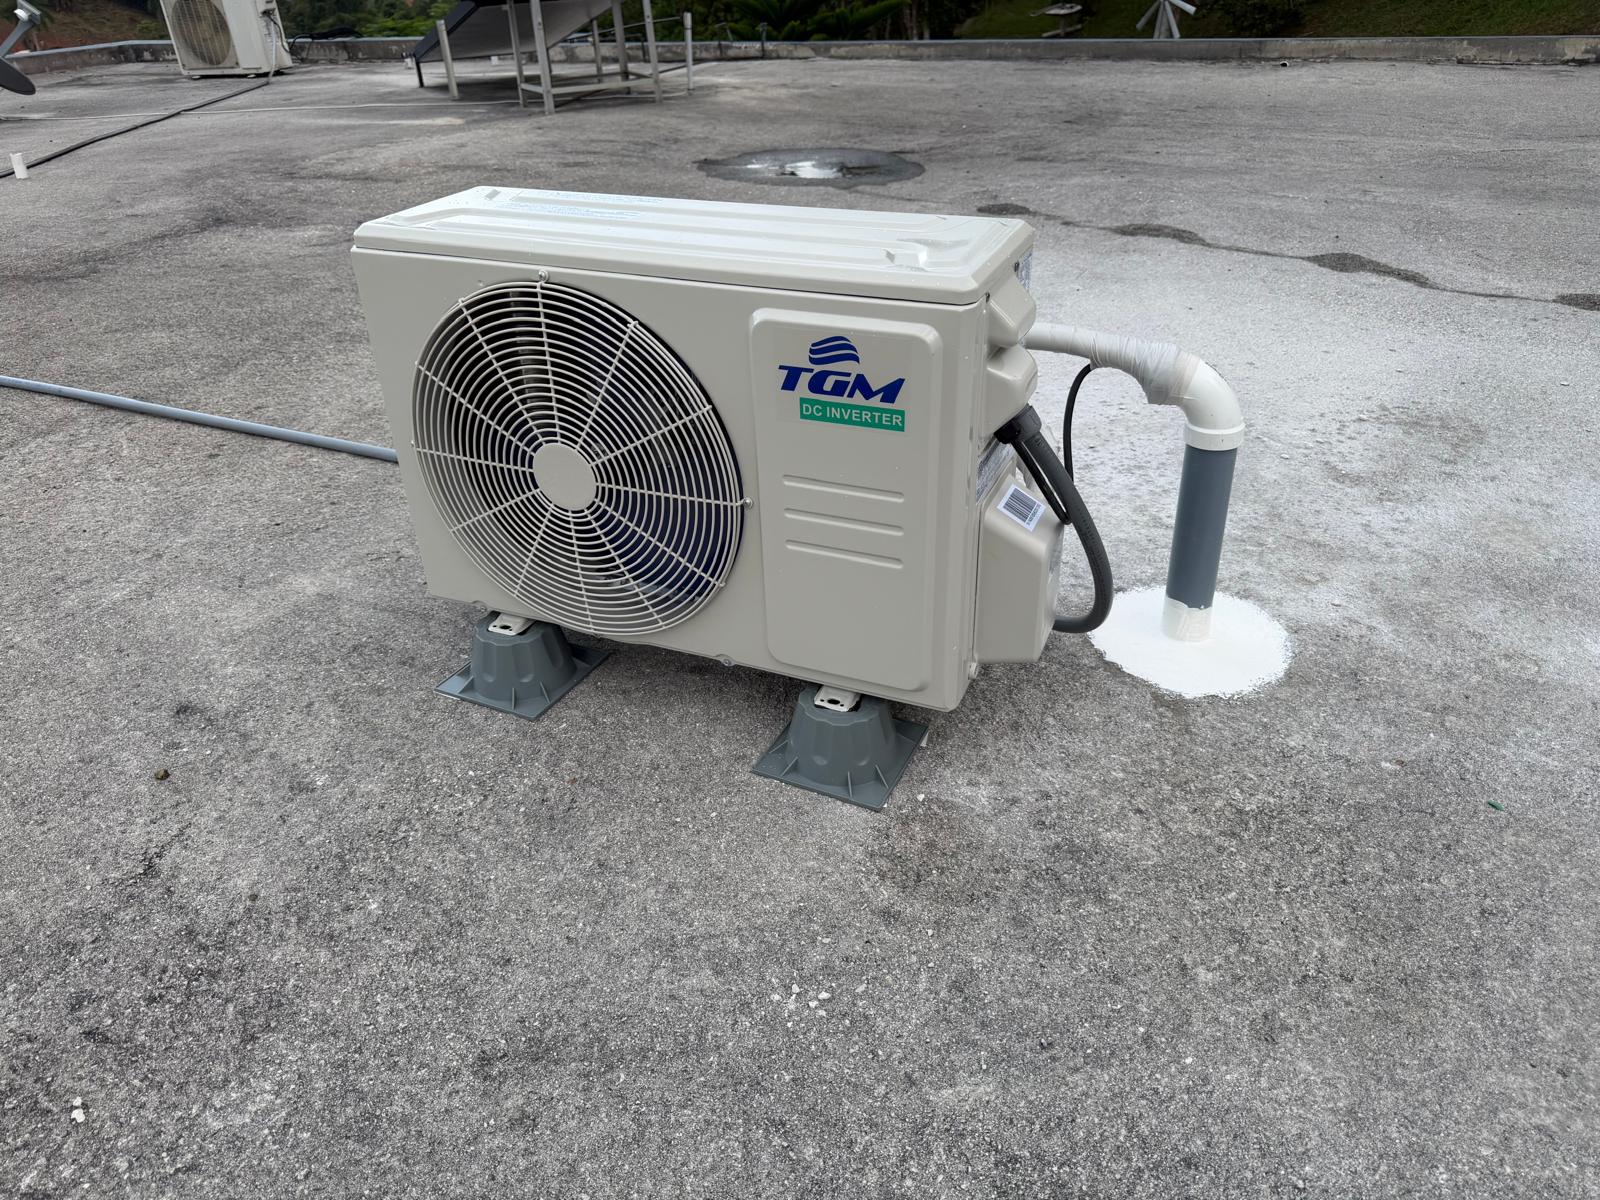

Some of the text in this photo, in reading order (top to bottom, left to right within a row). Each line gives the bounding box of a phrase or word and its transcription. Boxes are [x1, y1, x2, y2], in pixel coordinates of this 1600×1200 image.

[778, 365, 905, 404] TGM
[802, 403, 902, 426] DC INVERTER
